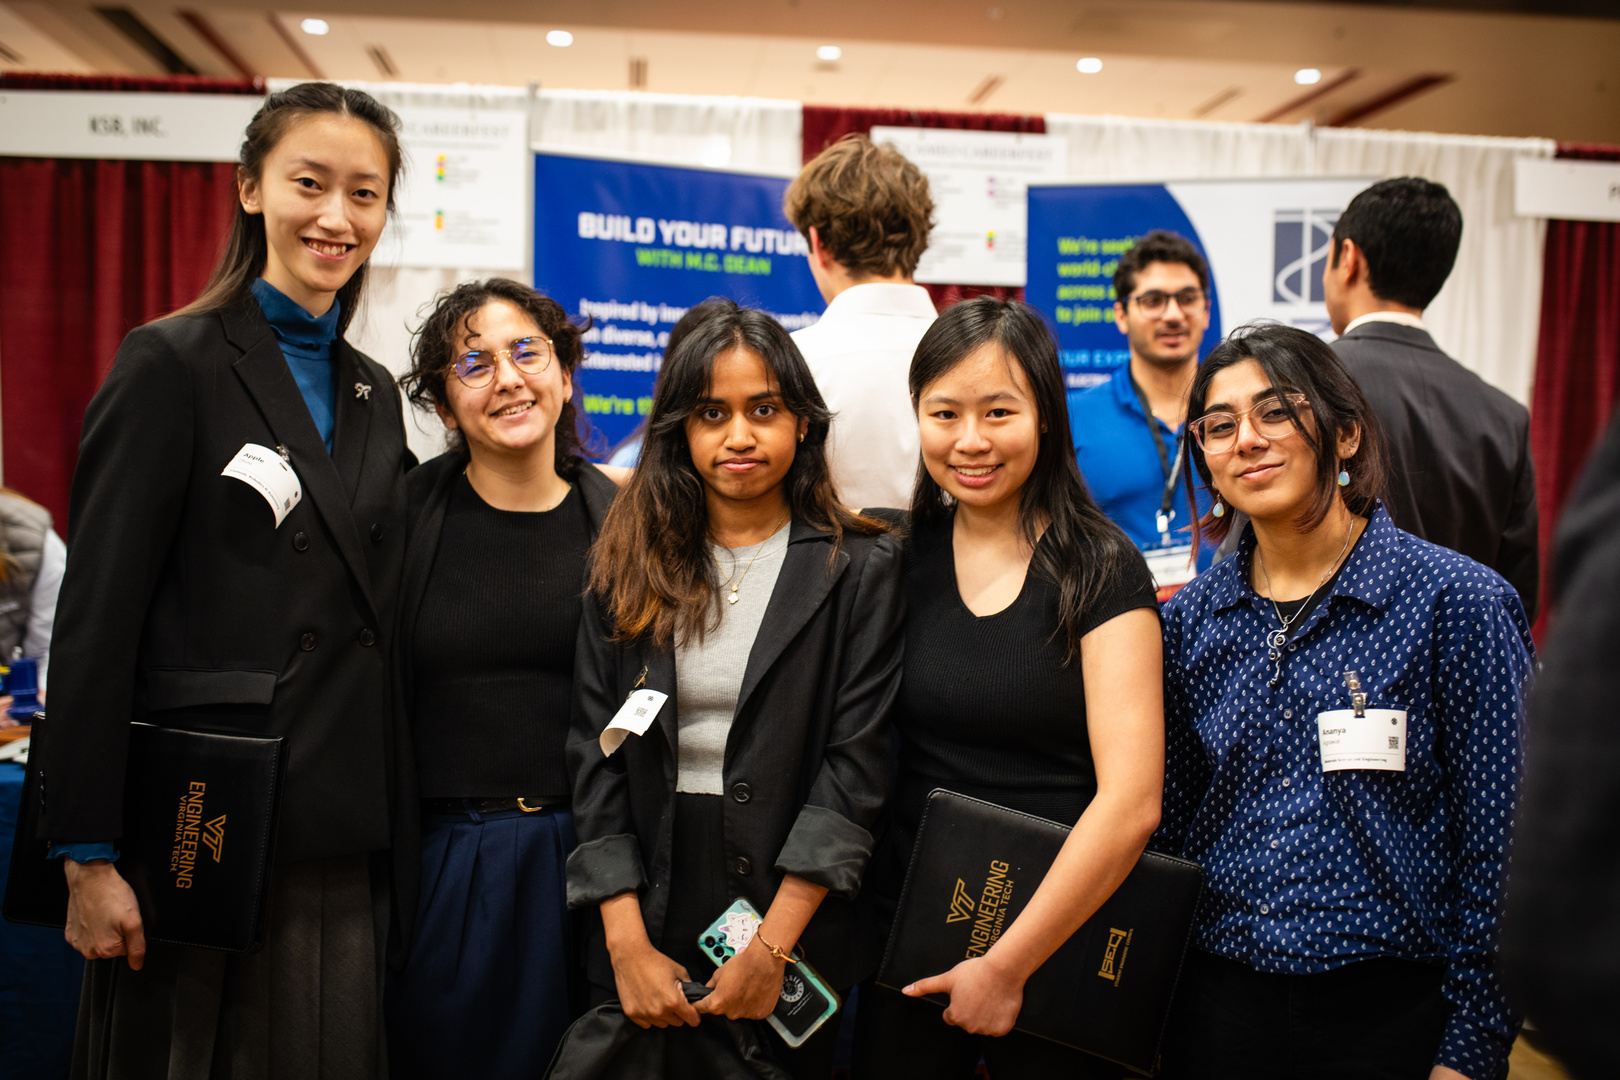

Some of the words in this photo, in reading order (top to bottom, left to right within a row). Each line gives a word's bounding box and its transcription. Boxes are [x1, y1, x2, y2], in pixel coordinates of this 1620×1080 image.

[578, 211, 656, 244] BUILD
[658, 218, 728, 251] YOUR
[730, 225, 809, 258] FUTUR
[1057, 235, 1099, 256] We're
[635, 247, 684, 269] WITH
[685, 251, 723, 273] M.C.
[723, 253, 772, 276] DEAN
[1056, 284, 1106, 301] across
[579, 298, 640, 323] Inspired
[640, 301, 659, 326] by
[1055, 304, 1073, 323] to
[1073, 303, 1103, 327] join
[602, 325, 657, 350] diverse,
[583, 394, 635, 415] We're
[243, 453, 265, 464] Apple
[1322, 727, 1347, 737] Ananya
[174, 794, 188, 842] VIRGINIA
[176, 781, 206, 889] ENGINEERING
[171, 844, 181, 872] TECH
[1000, 879, 1015, 905] TECH
